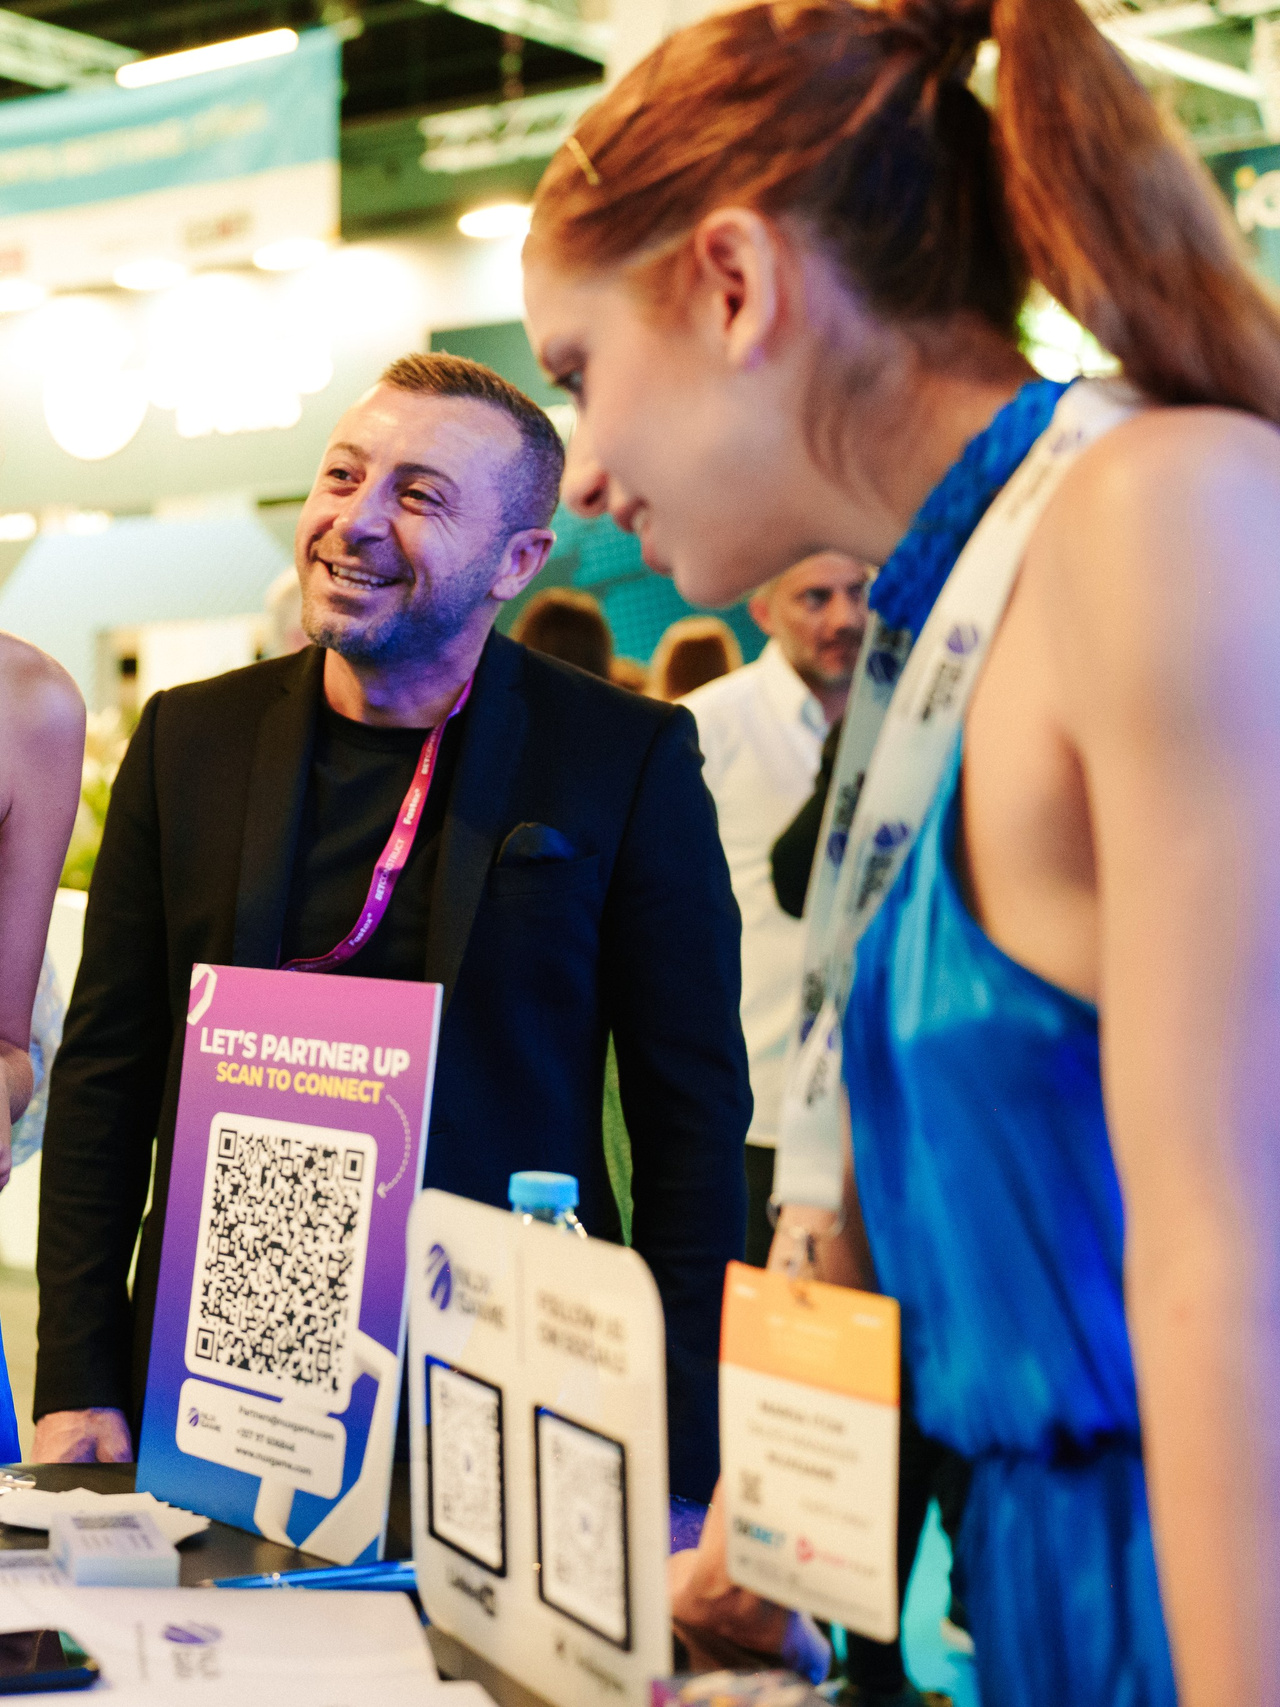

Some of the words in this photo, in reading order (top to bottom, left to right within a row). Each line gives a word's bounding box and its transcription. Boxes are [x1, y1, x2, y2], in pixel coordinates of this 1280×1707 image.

[200, 1026, 258, 1058] LET'S
[260, 1034, 370, 1074] PARTNER
[373, 1046, 410, 1078] UP
[216, 1061, 264, 1088] SCAN
[266, 1068, 291, 1092] TO
[293, 1071, 385, 1104] CONNECT
